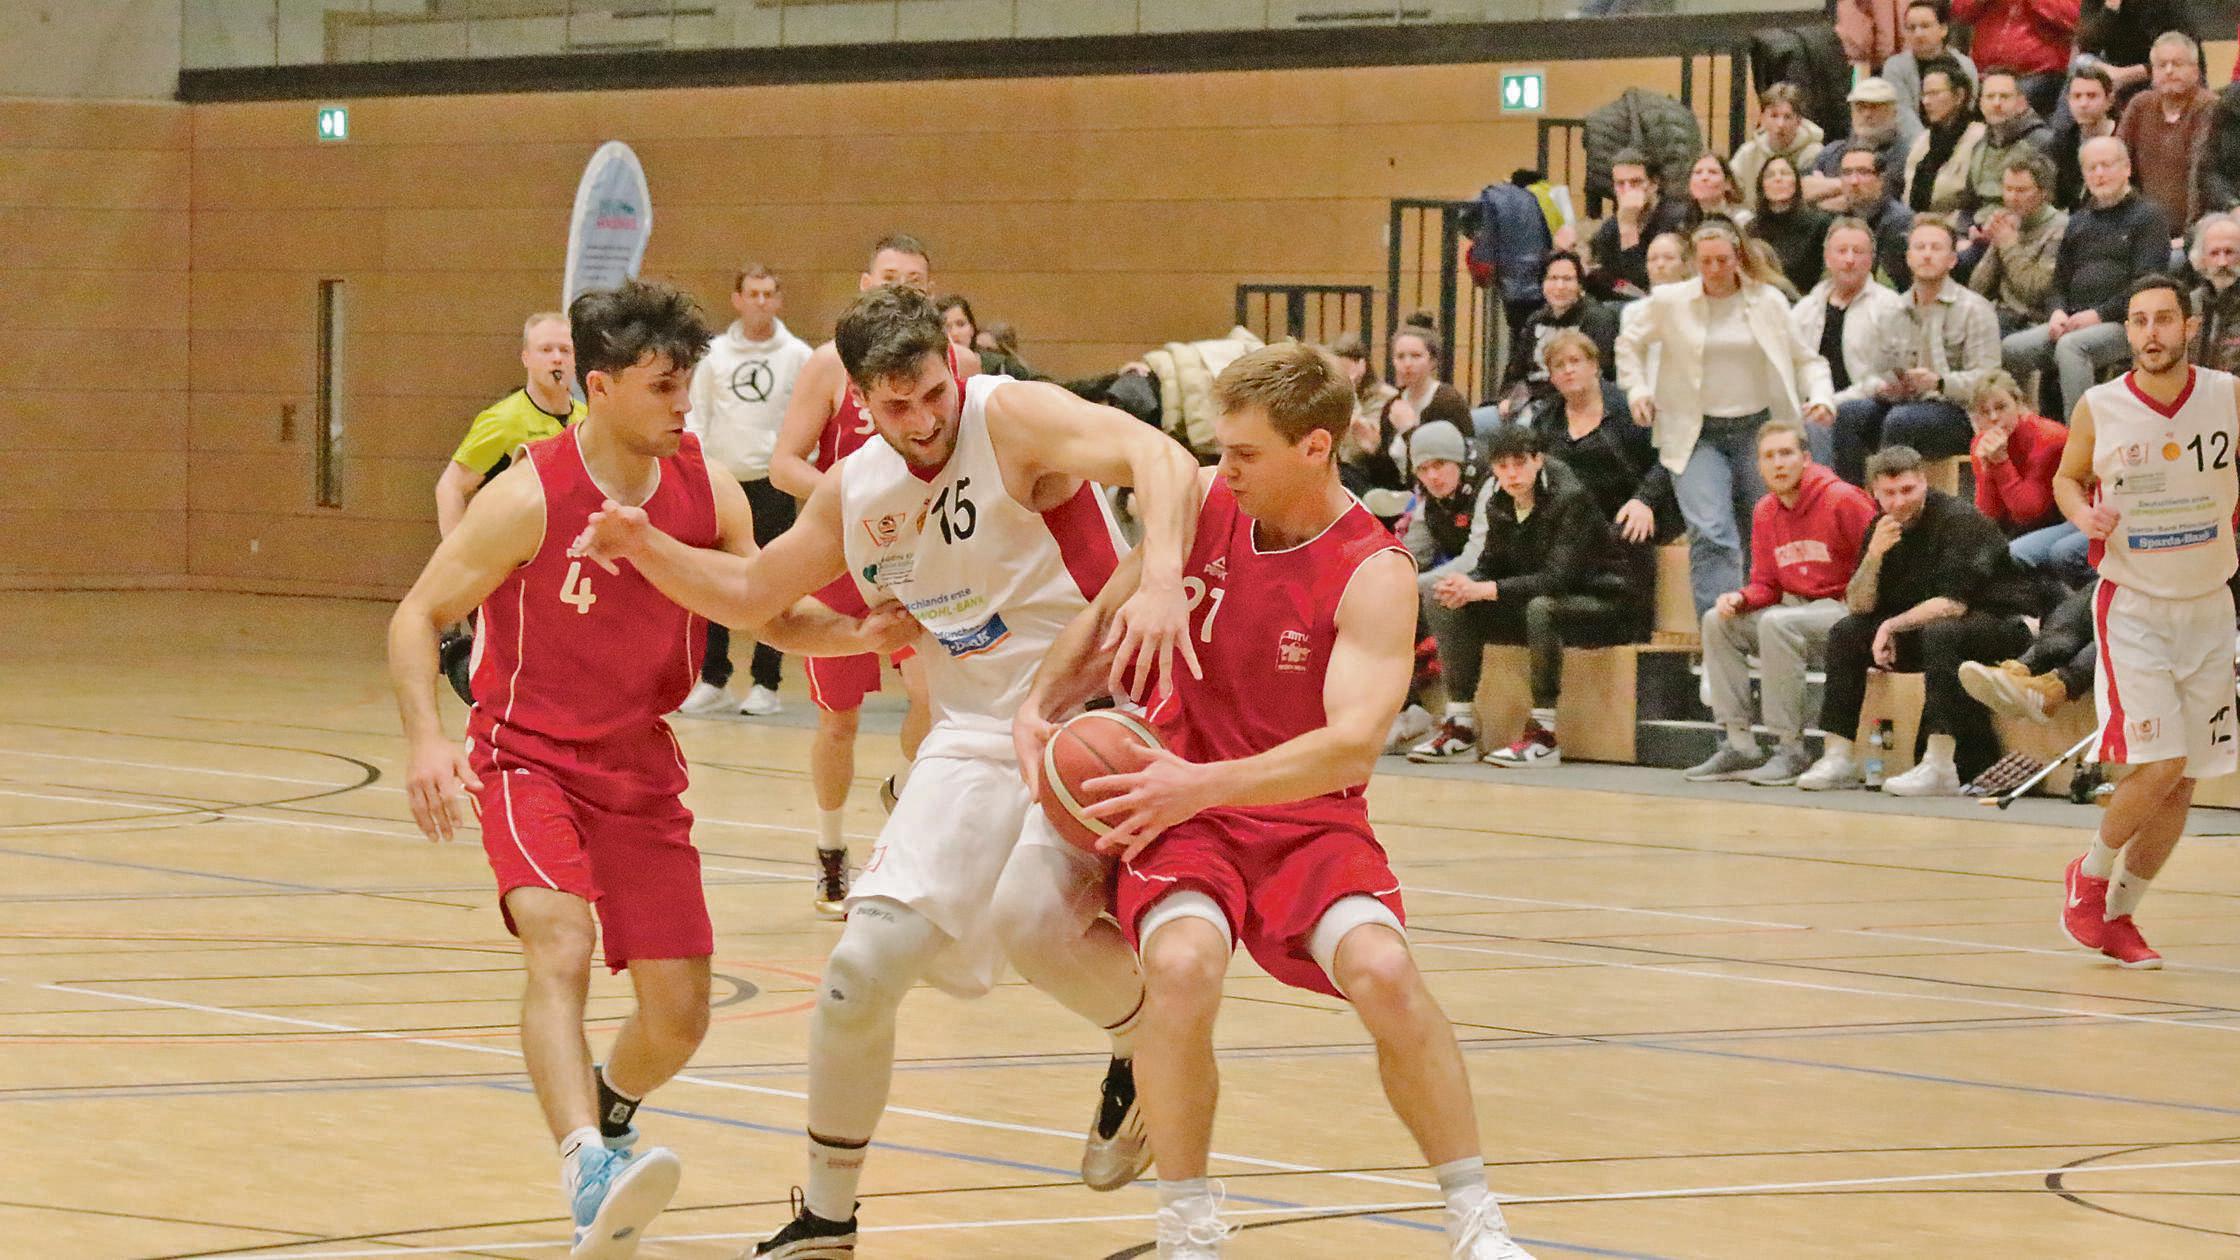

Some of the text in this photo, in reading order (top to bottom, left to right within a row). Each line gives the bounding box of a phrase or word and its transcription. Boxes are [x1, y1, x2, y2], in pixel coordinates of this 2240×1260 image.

[2187, 430, 2229, 472] 12
[930, 477, 977, 545] 15
[560, 561, 597, 614] 4
[950, 587, 971, 600] erste
